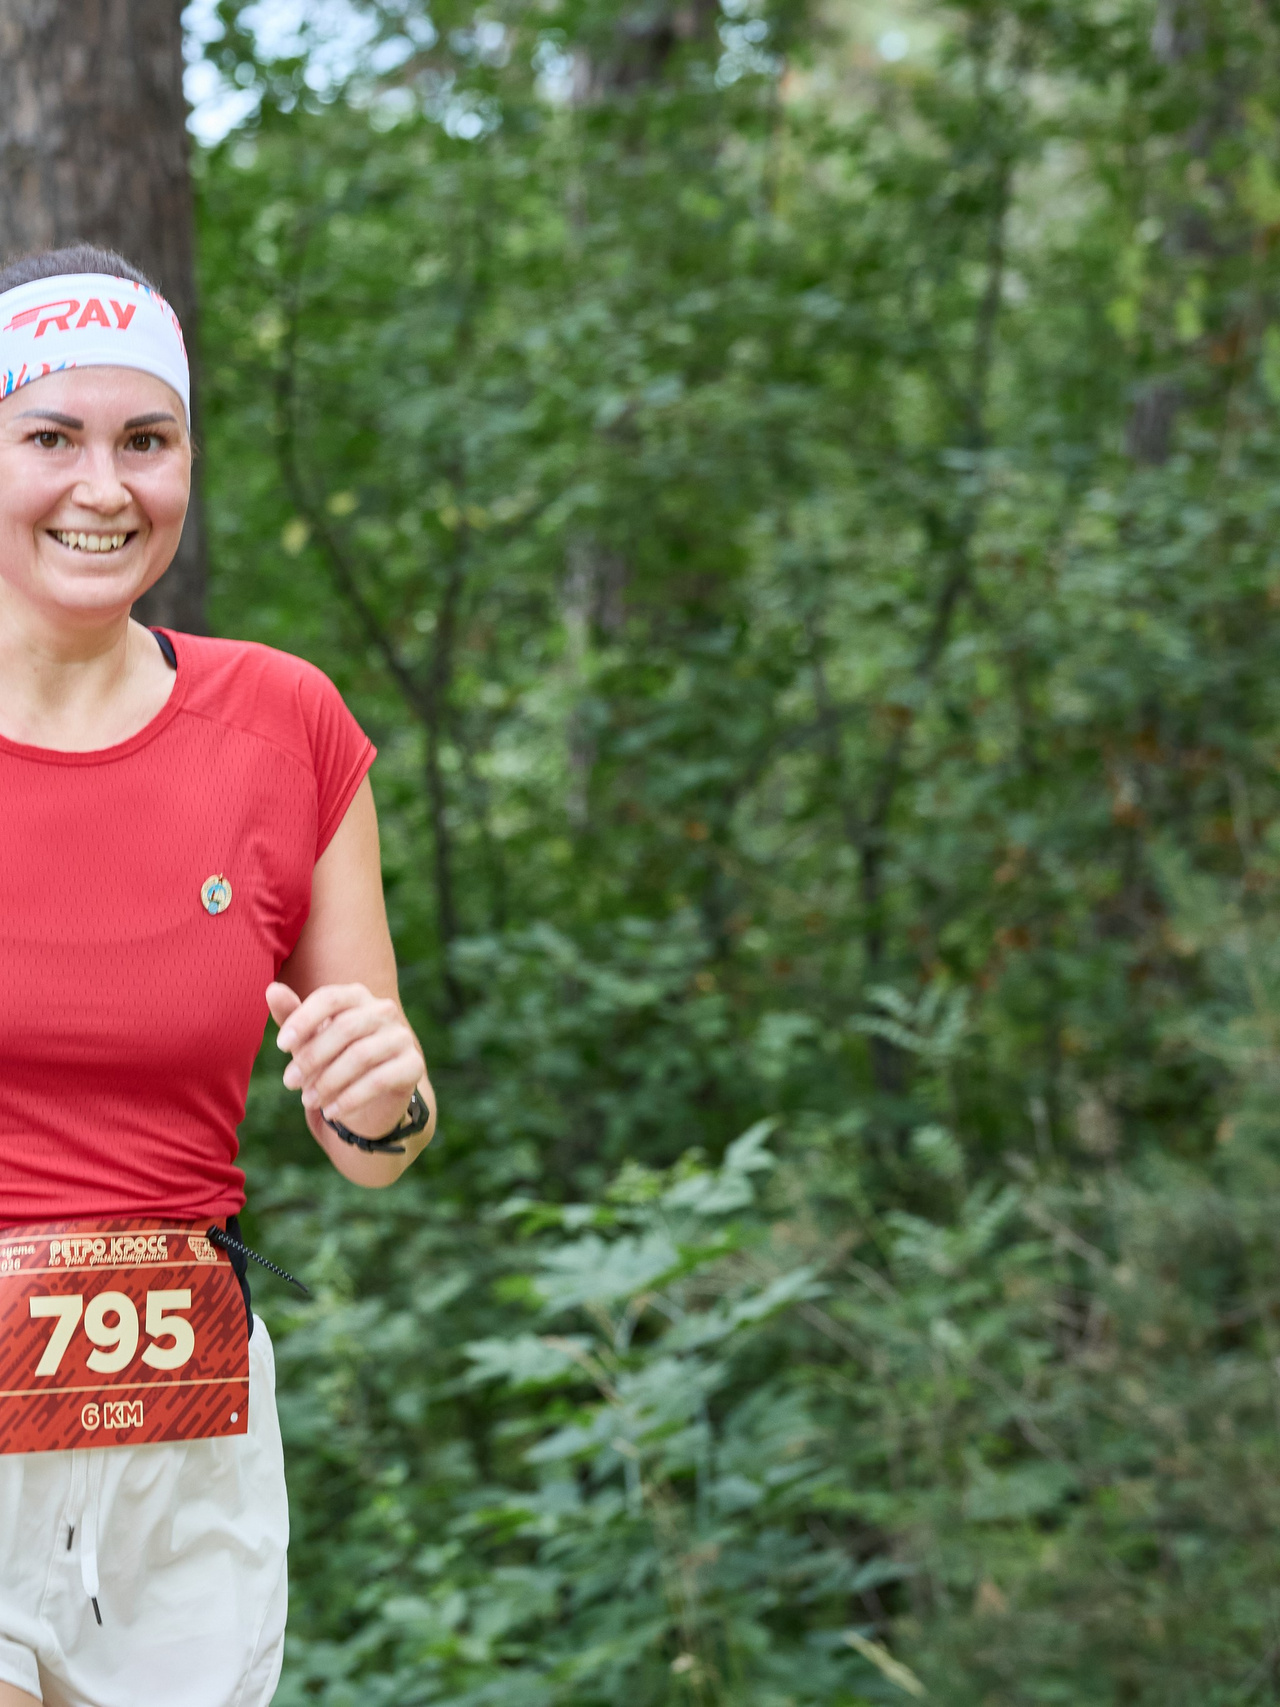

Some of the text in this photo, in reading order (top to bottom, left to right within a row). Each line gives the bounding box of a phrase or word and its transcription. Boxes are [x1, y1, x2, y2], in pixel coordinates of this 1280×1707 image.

[3, 298, 136, 339] RAY
[49, 1238, 107, 1258] РЕТРО
[111, 1235, 168, 1256] КРОСС
[29, 1288, 195, 1377] 795
[81, 1403, 100, 1431] 6
